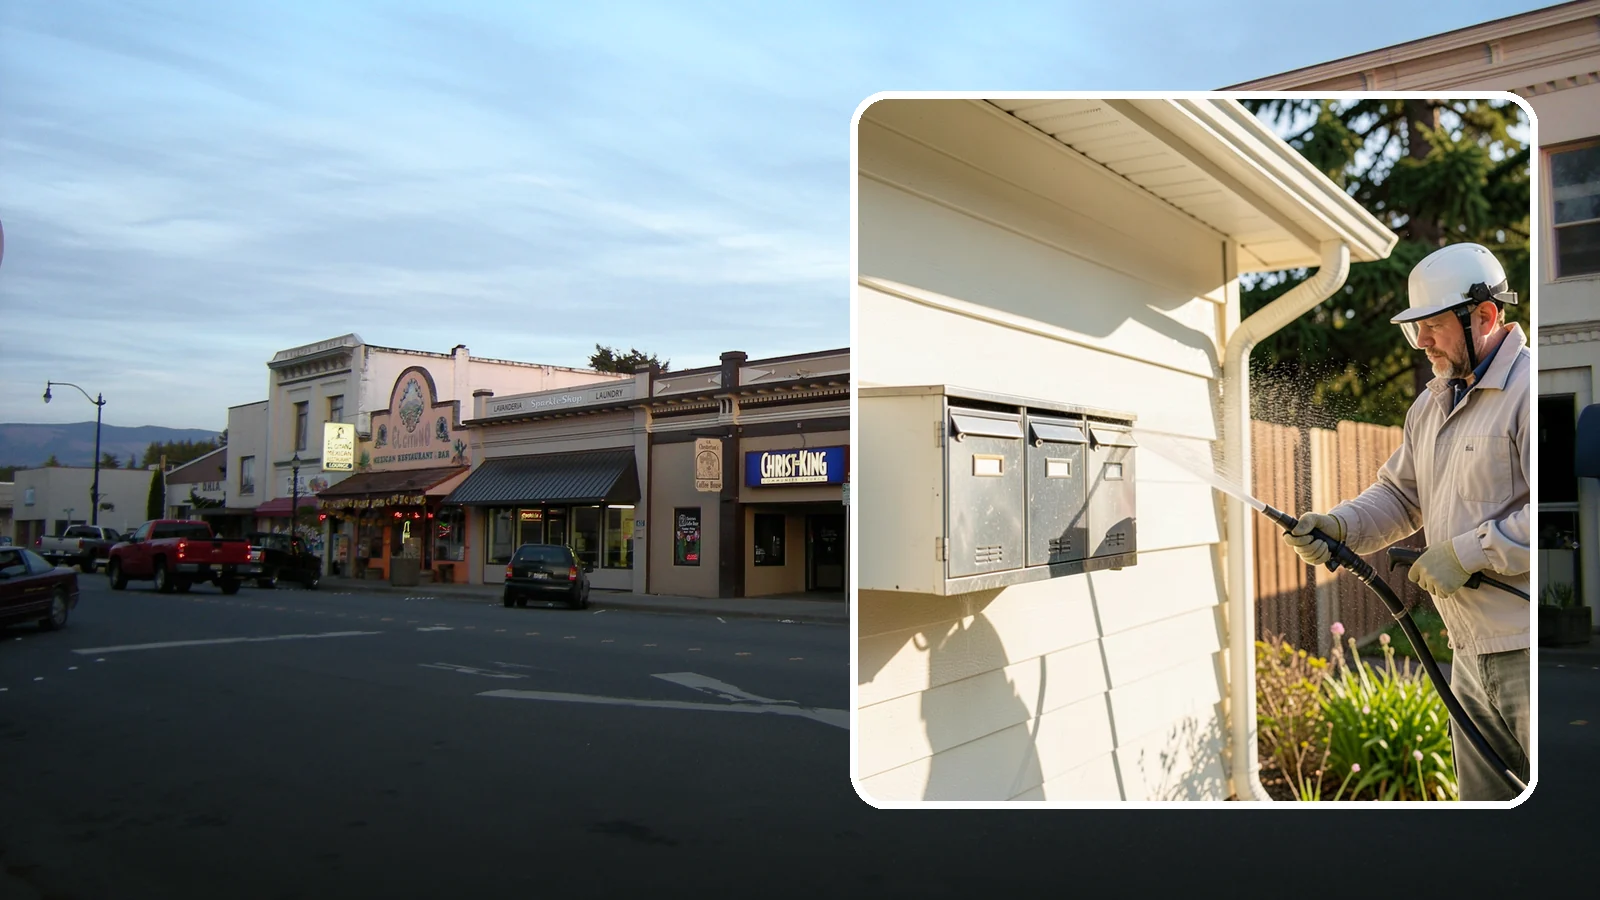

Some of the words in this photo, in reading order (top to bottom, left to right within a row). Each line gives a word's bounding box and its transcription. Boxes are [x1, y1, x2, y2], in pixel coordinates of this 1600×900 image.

[531, 396, 561, 409] Sparkle
[561, 394, 582, 404] Shop
[595, 389, 623, 400] LAUNDRY
[494, 402, 522, 412] LAVANDERIA
[374, 456, 396, 464] MEXICAN
[398, 451, 433, 462] RESTAURANT
[438, 450, 450, 459] BAR
[761, 452, 797, 478] CHRIST
[799, 450, 828, 477] KING
